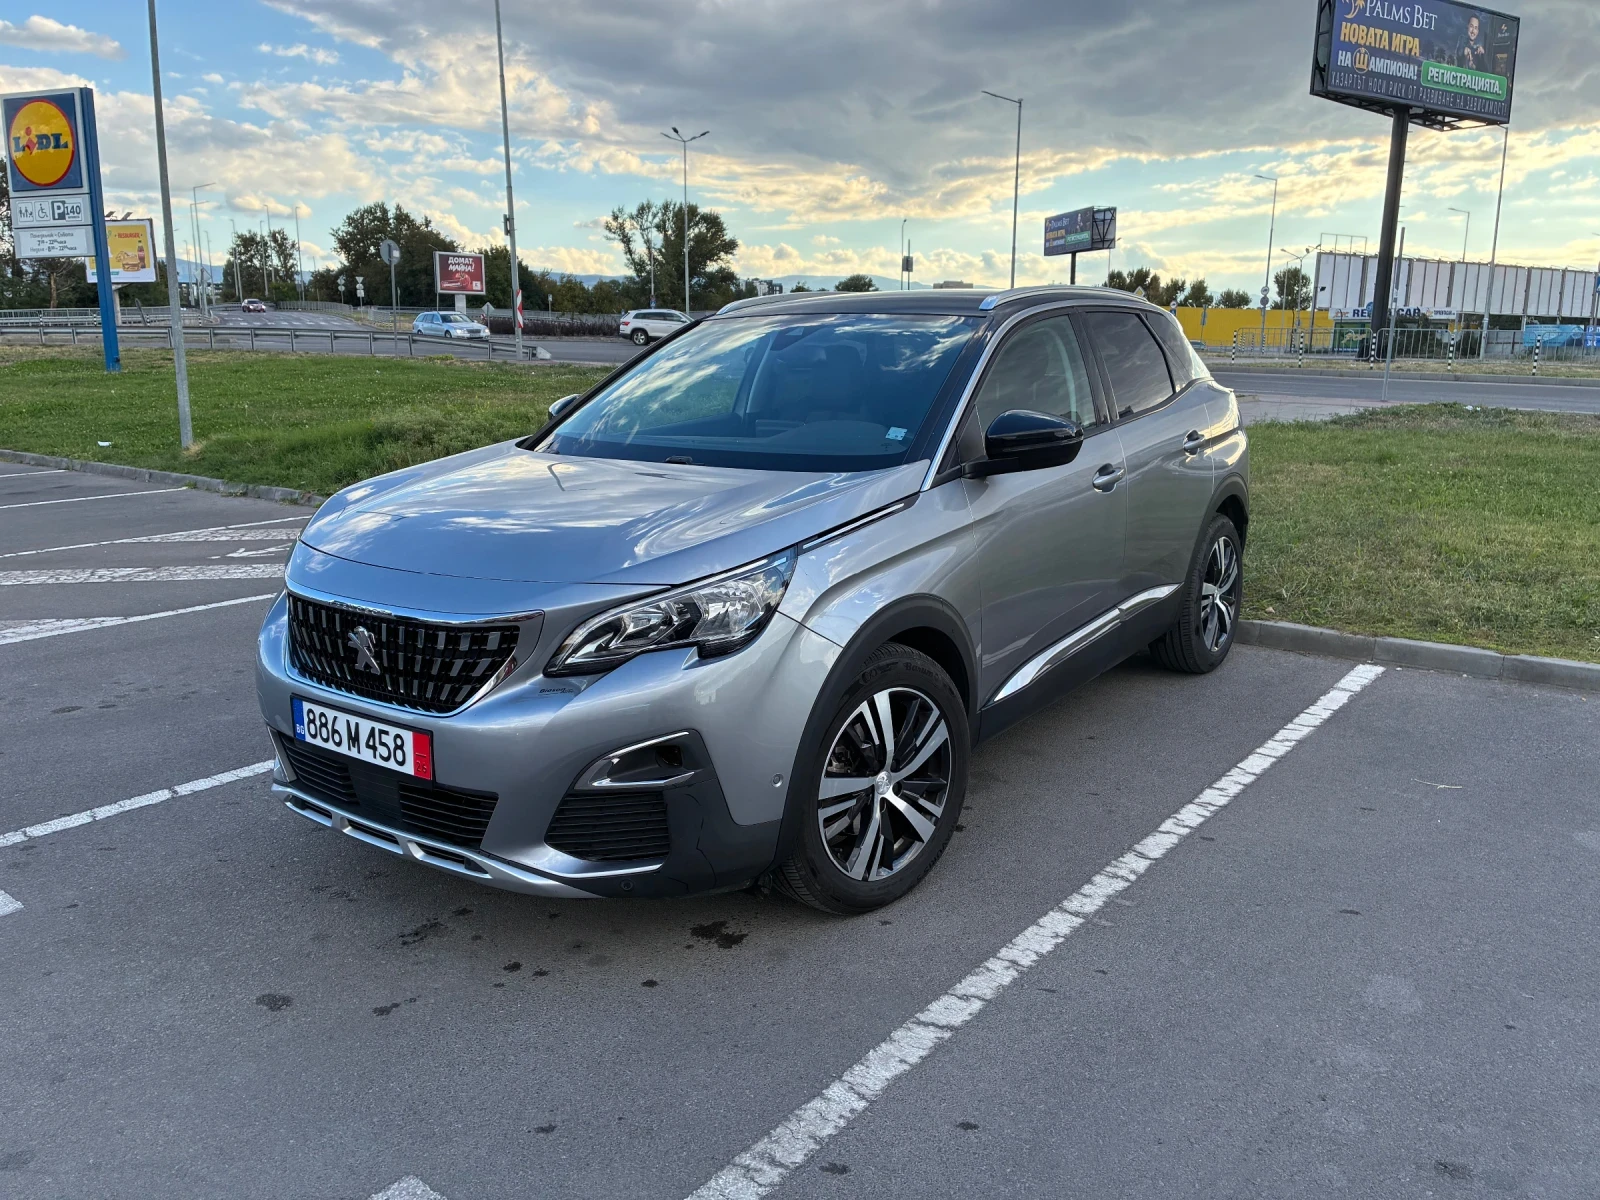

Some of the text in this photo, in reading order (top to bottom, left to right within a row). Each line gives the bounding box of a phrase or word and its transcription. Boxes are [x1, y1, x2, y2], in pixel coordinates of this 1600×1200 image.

[1365, 0, 1437, 31] PALMS BET
[1340, 22, 1420, 56] НОВАТА ИГРА
[1337, 50, 1350, 68] НА
[1331, 71, 1366, 90] ХАЗАРТЪТ
[1368, 77, 1386, 93] НОСИ
[1389, 81, 1406, 97] РИСК
[1408, 85, 1416, 99] ОТ
[1419, 87, 1454, 107] РАЗВИВАНЕ
[1455, 94, 1464, 108] НА
[1428, 66, 1502, 95] РЕГИСТРАЦИЯТА.
[65, 205, 81, 215] 140
[296, 723, 305, 735] BG
[416, 761, 427, 774] 26
